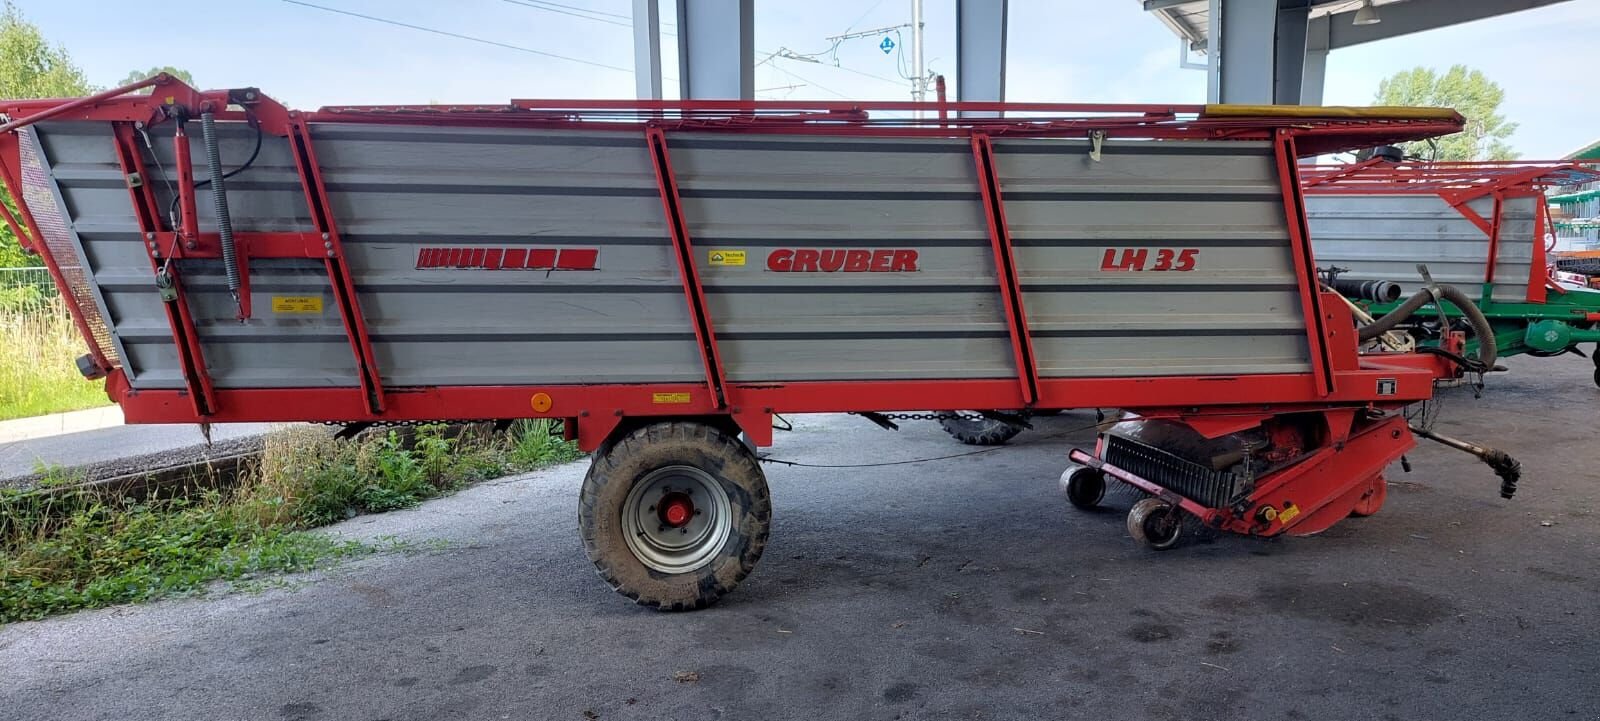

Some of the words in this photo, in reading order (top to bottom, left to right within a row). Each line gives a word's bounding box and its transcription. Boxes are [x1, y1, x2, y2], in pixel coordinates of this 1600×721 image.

[767, 249, 919, 272] GRUBER
[1101, 249, 1148, 271] LH
[1152, 249, 1200, 271] 35
